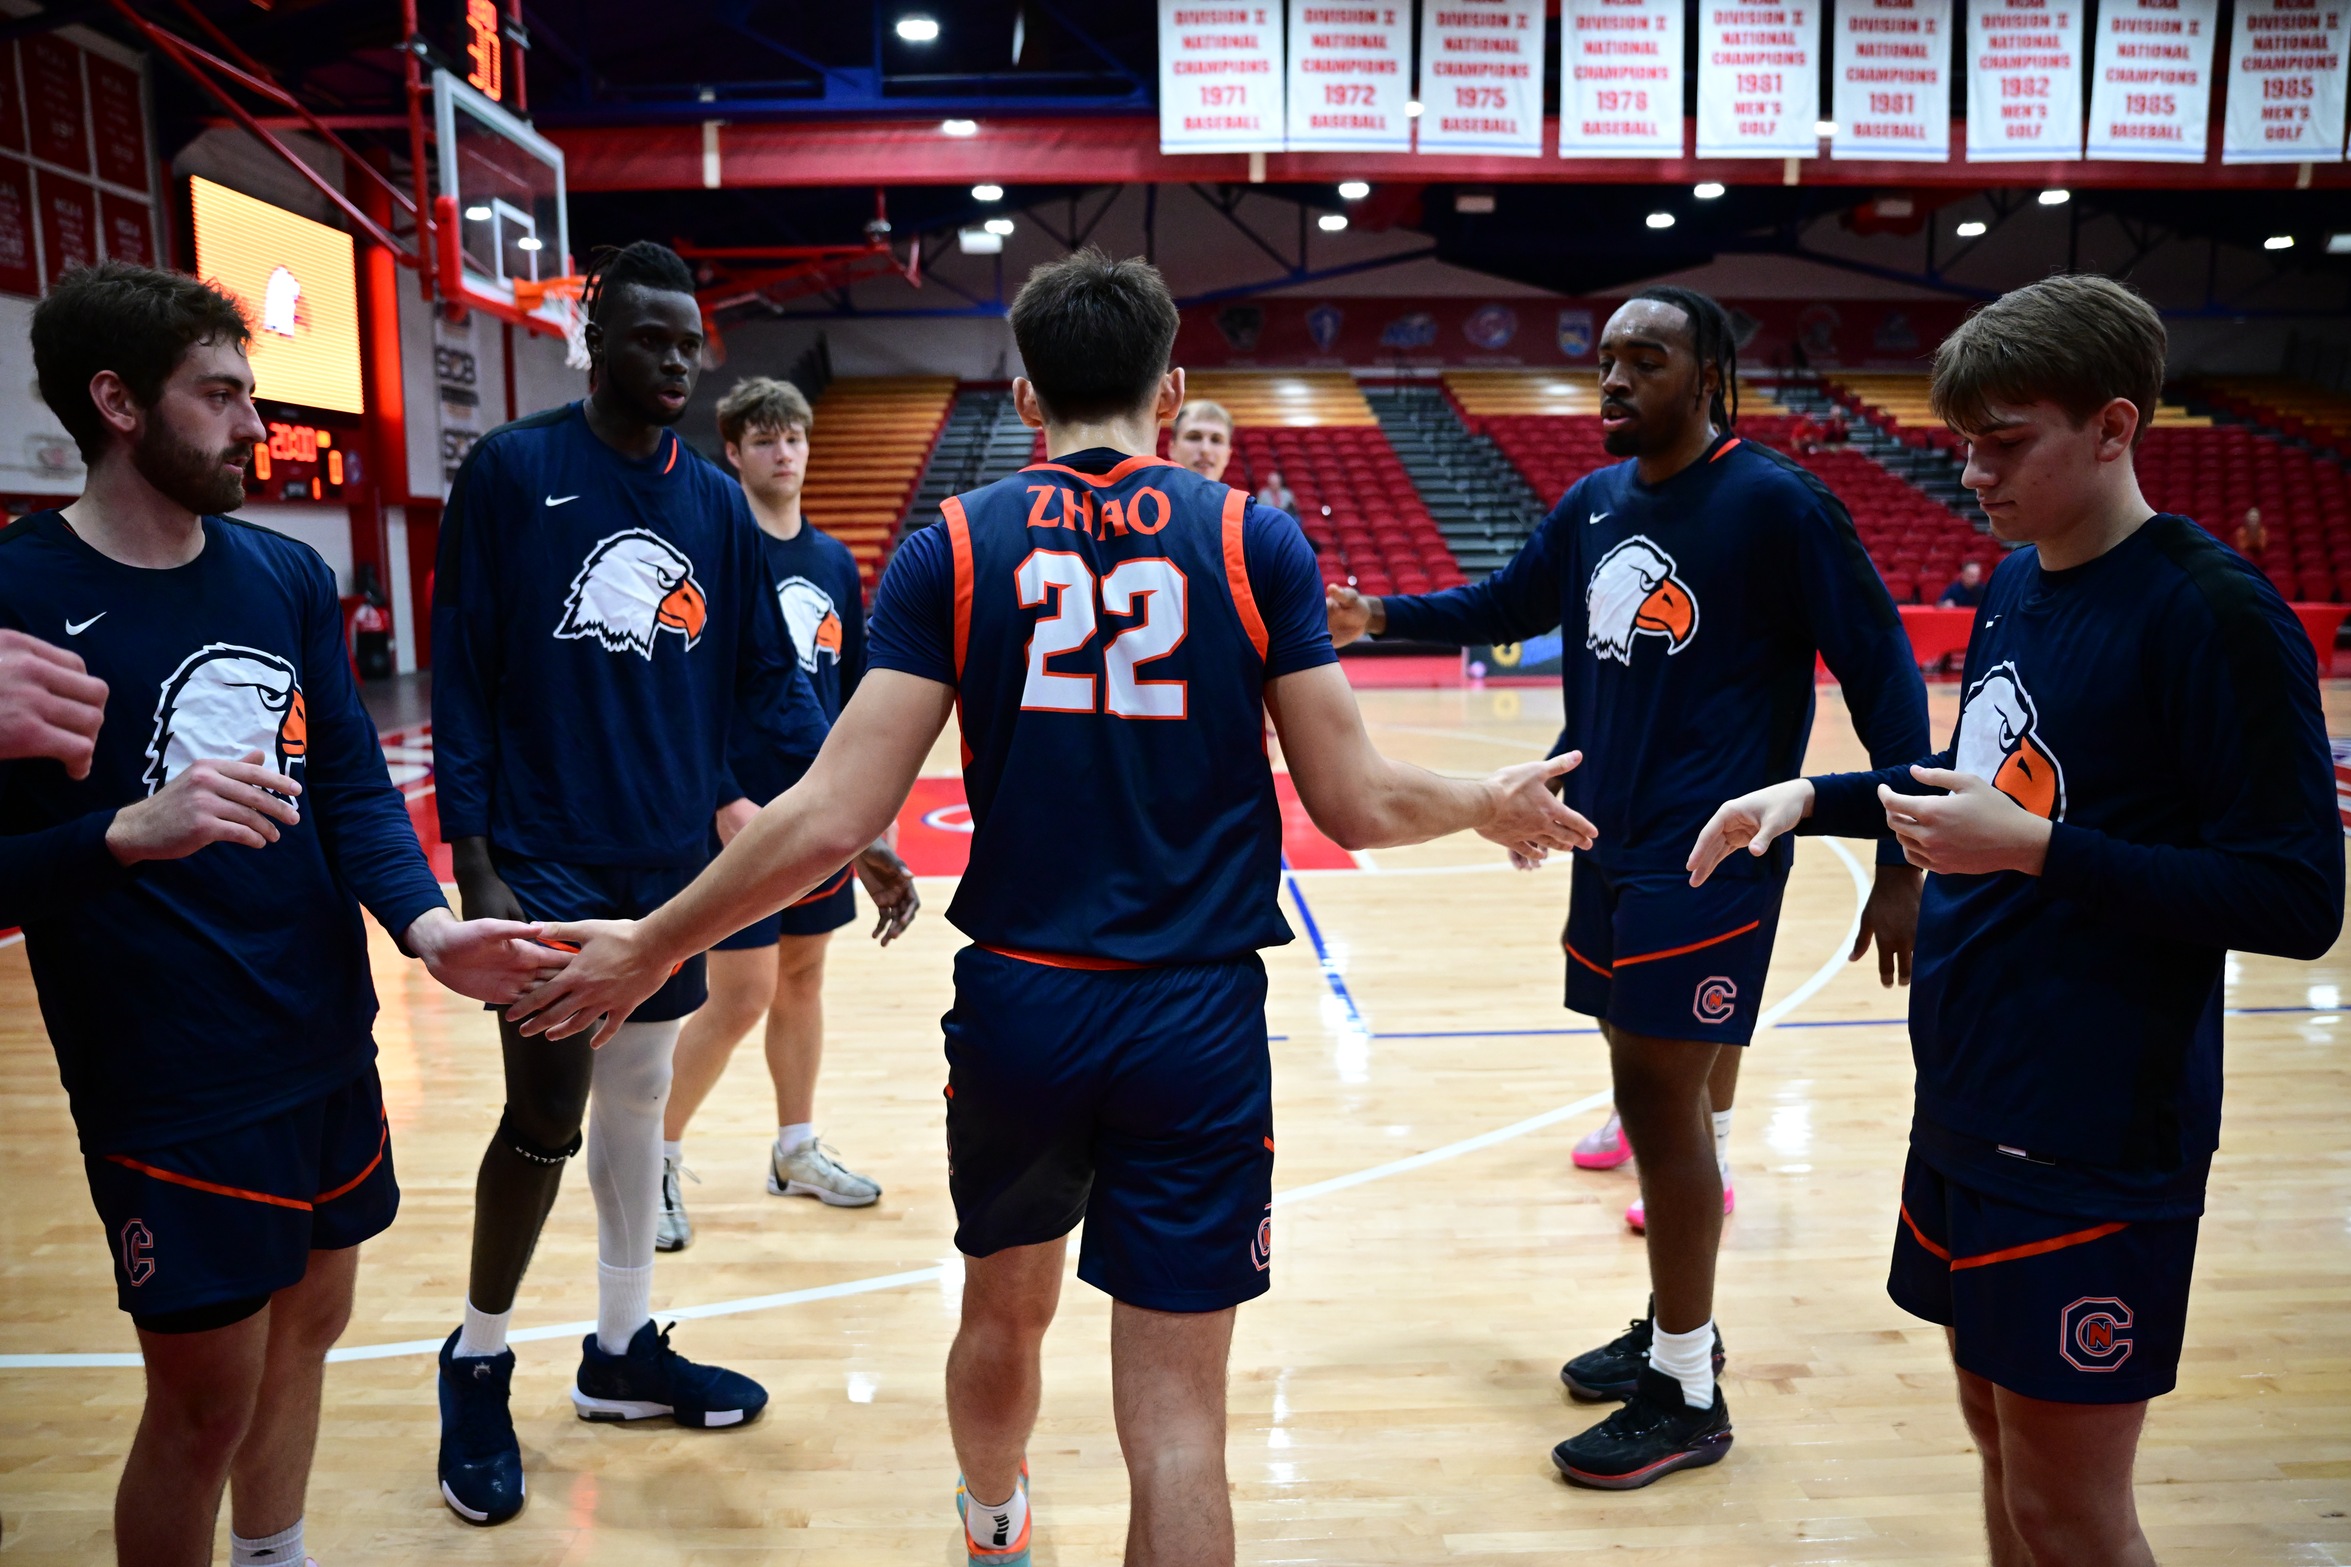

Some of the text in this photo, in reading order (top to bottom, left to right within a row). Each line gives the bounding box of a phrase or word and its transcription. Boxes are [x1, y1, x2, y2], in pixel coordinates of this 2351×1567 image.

[1174, 9, 1248, 25] DIVISION
[1304, 9, 1378, 24] DIVISION
[1437, 12, 1510, 28] DIVISION
[1575, 15, 1650, 31] DIVISION
[1714, 10, 1786, 25] DIVISION
[1981, 14, 2051, 28] DIVISION
[2247, 15, 2320, 30] DIVISION
[1849, 17, 1920, 33] DIVISION
[2111, 18, 2183, 34] DIVISION
[1182, 35, 1258, 50] NATIONAL
[1311, 33, 1387, 49] NATIONAL
[1443, 37, 1519, 53] NATIONAL
[1721, 31, 1796, 46] NATIONAL
[1988, 35, 2060, 49] NATIONAL
[2253, 35, 2328, 50] NATIONAL
[1583, 40, 1658, 55] NATIONAL
[1856, 42, 1928, 58] NATIONAL
[2117, 43, 2190, 60] NATIONAL
[466, 14, 502, 102] 30
[1301, 58, 1398, 74] CHAMPIONS
[1712, 51, 1806, 66] CHAMPIONS
[1979, 54, 2071, 70] CHAMPIONS
[2241, 55, 2338, 71] CHAMPIONS
[1173, 60, 1270, 75] CHAMPIONS
[1433, 61, 1529, 78] CHAMPIONS
[1573, 65, 1669, 80] CHAMPIONS
[1846, 67, 1938, 84] CHAMPIONS
[1736, 73, 1783, 94] 1981
[2105, 68, 2198, 85] CHAMPIONS
[1200, 85, 1246, 105] 1971
[1324, 83, 1377, 106] 1972
[2000, 76, 2051, 98] 1982
[2263, 77, 2314, 99] 1985
[1455, 86, 1507, 109] 1975
[1596, 90, 1648, 111] 1978
[1869, 92, 1915, 114] 1981
[2125, 93, 2177, 116] 1985
[1734, 101, 1782, 115] MEN'S
[2000, 104, 2048, 119] MEN'S
[2261, 105, 2311, 121] MEN'S
[1183, 116, 1259, 130] BASEBALL
[1309, 114, 1386, 130] BASEBALL
[1440, 117, 1517, 133] BASEBALL
[1582, 121, 1657, 137] BASEBALL
[1739, 121, 1777, 136] GOLF
[1852, 122, 1925, 140] BASEBALL
[2005, 124, 2042, 139] GOLF
[2109, 123, 2182, 141] BASEBALL
[2264, 126, 2304, 142] GOLF
[268, 422, 318, 463] 20:00
[328, 449, 344, 485] 0
[1026, 484, 1172, 542] ZHAO
[1013, 547, 1189, 721] 22
